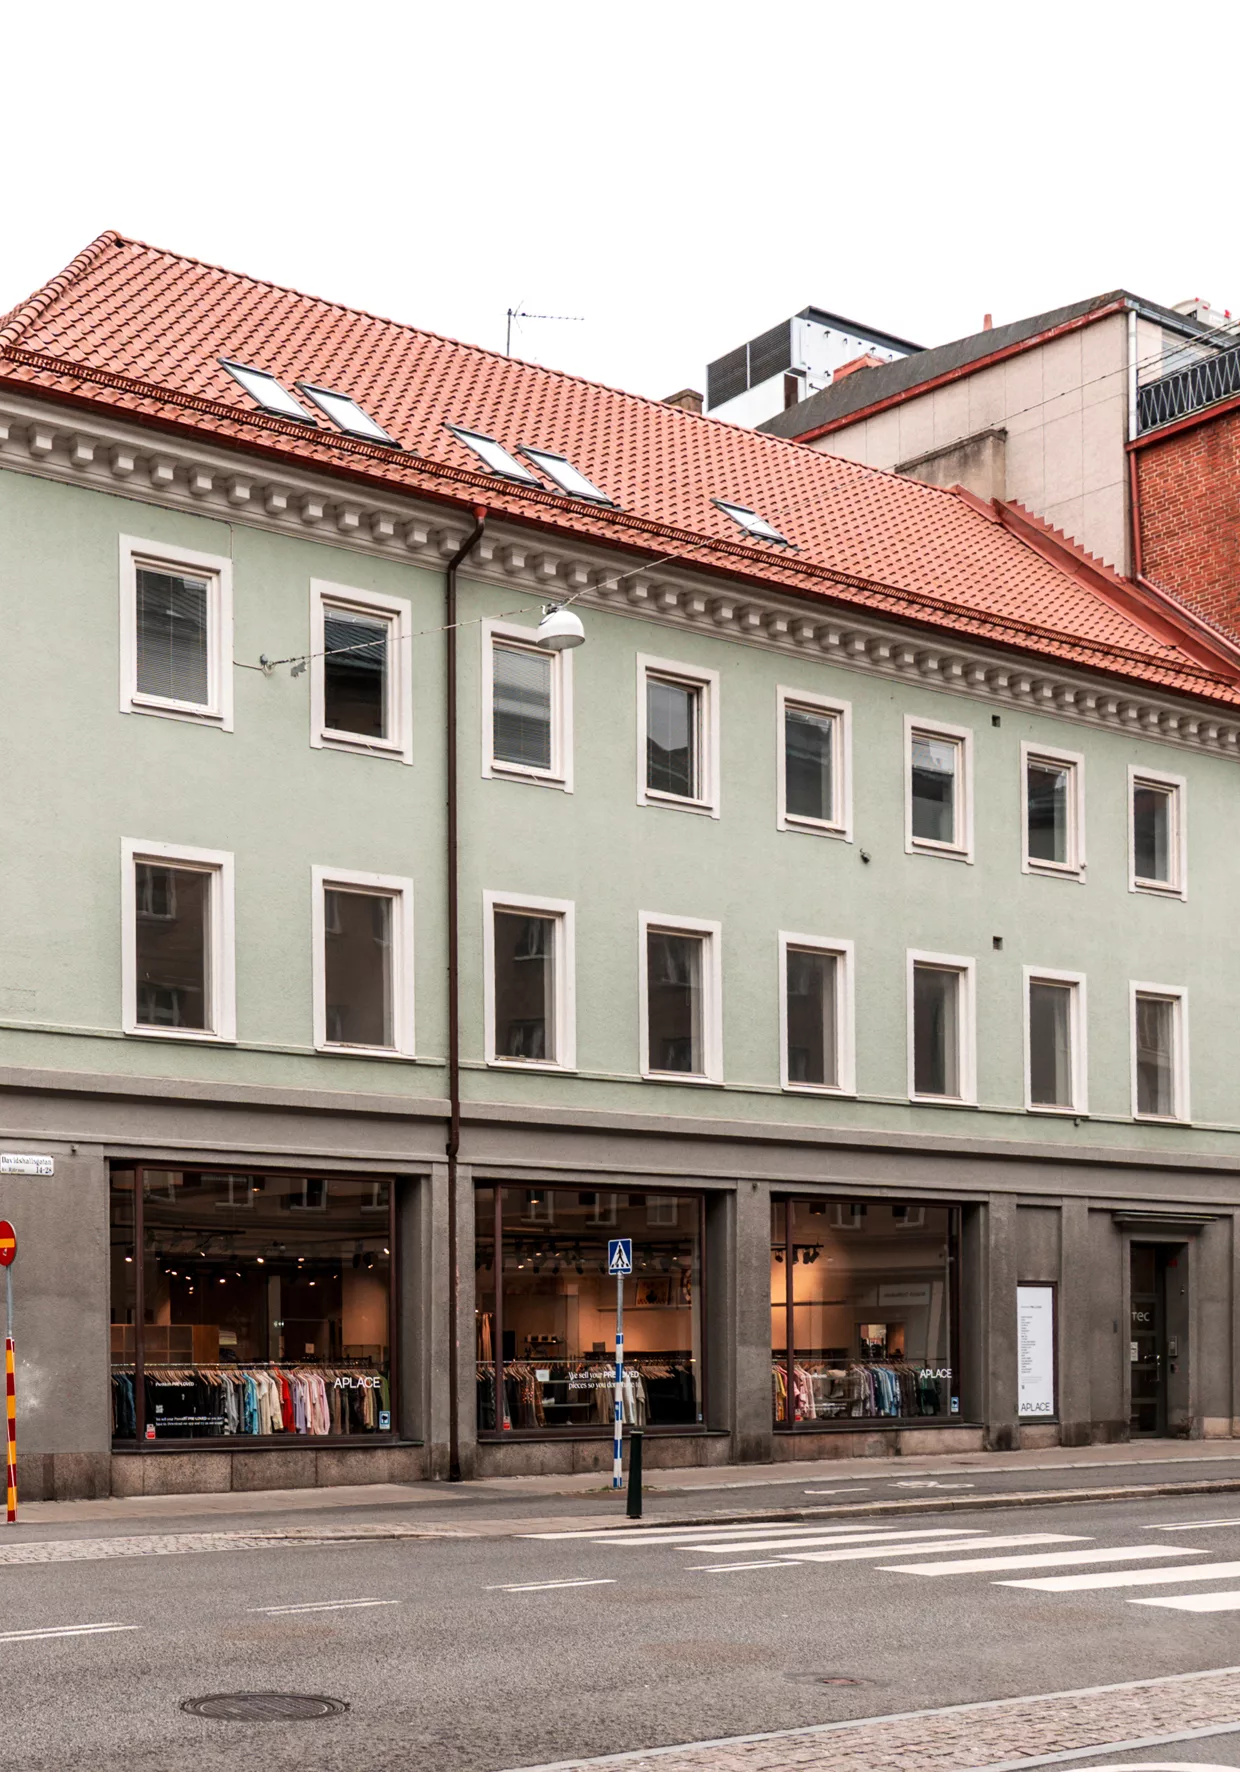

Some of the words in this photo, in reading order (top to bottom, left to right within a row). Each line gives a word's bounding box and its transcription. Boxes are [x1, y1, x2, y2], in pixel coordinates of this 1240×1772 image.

[920, 1368, 952, 1379] APLACE
[334, 1376, 380, 1389] APLACE
[568, 1382, 587, 1390] pieces
[1021, 1402, 1050, 1412] APLACE
